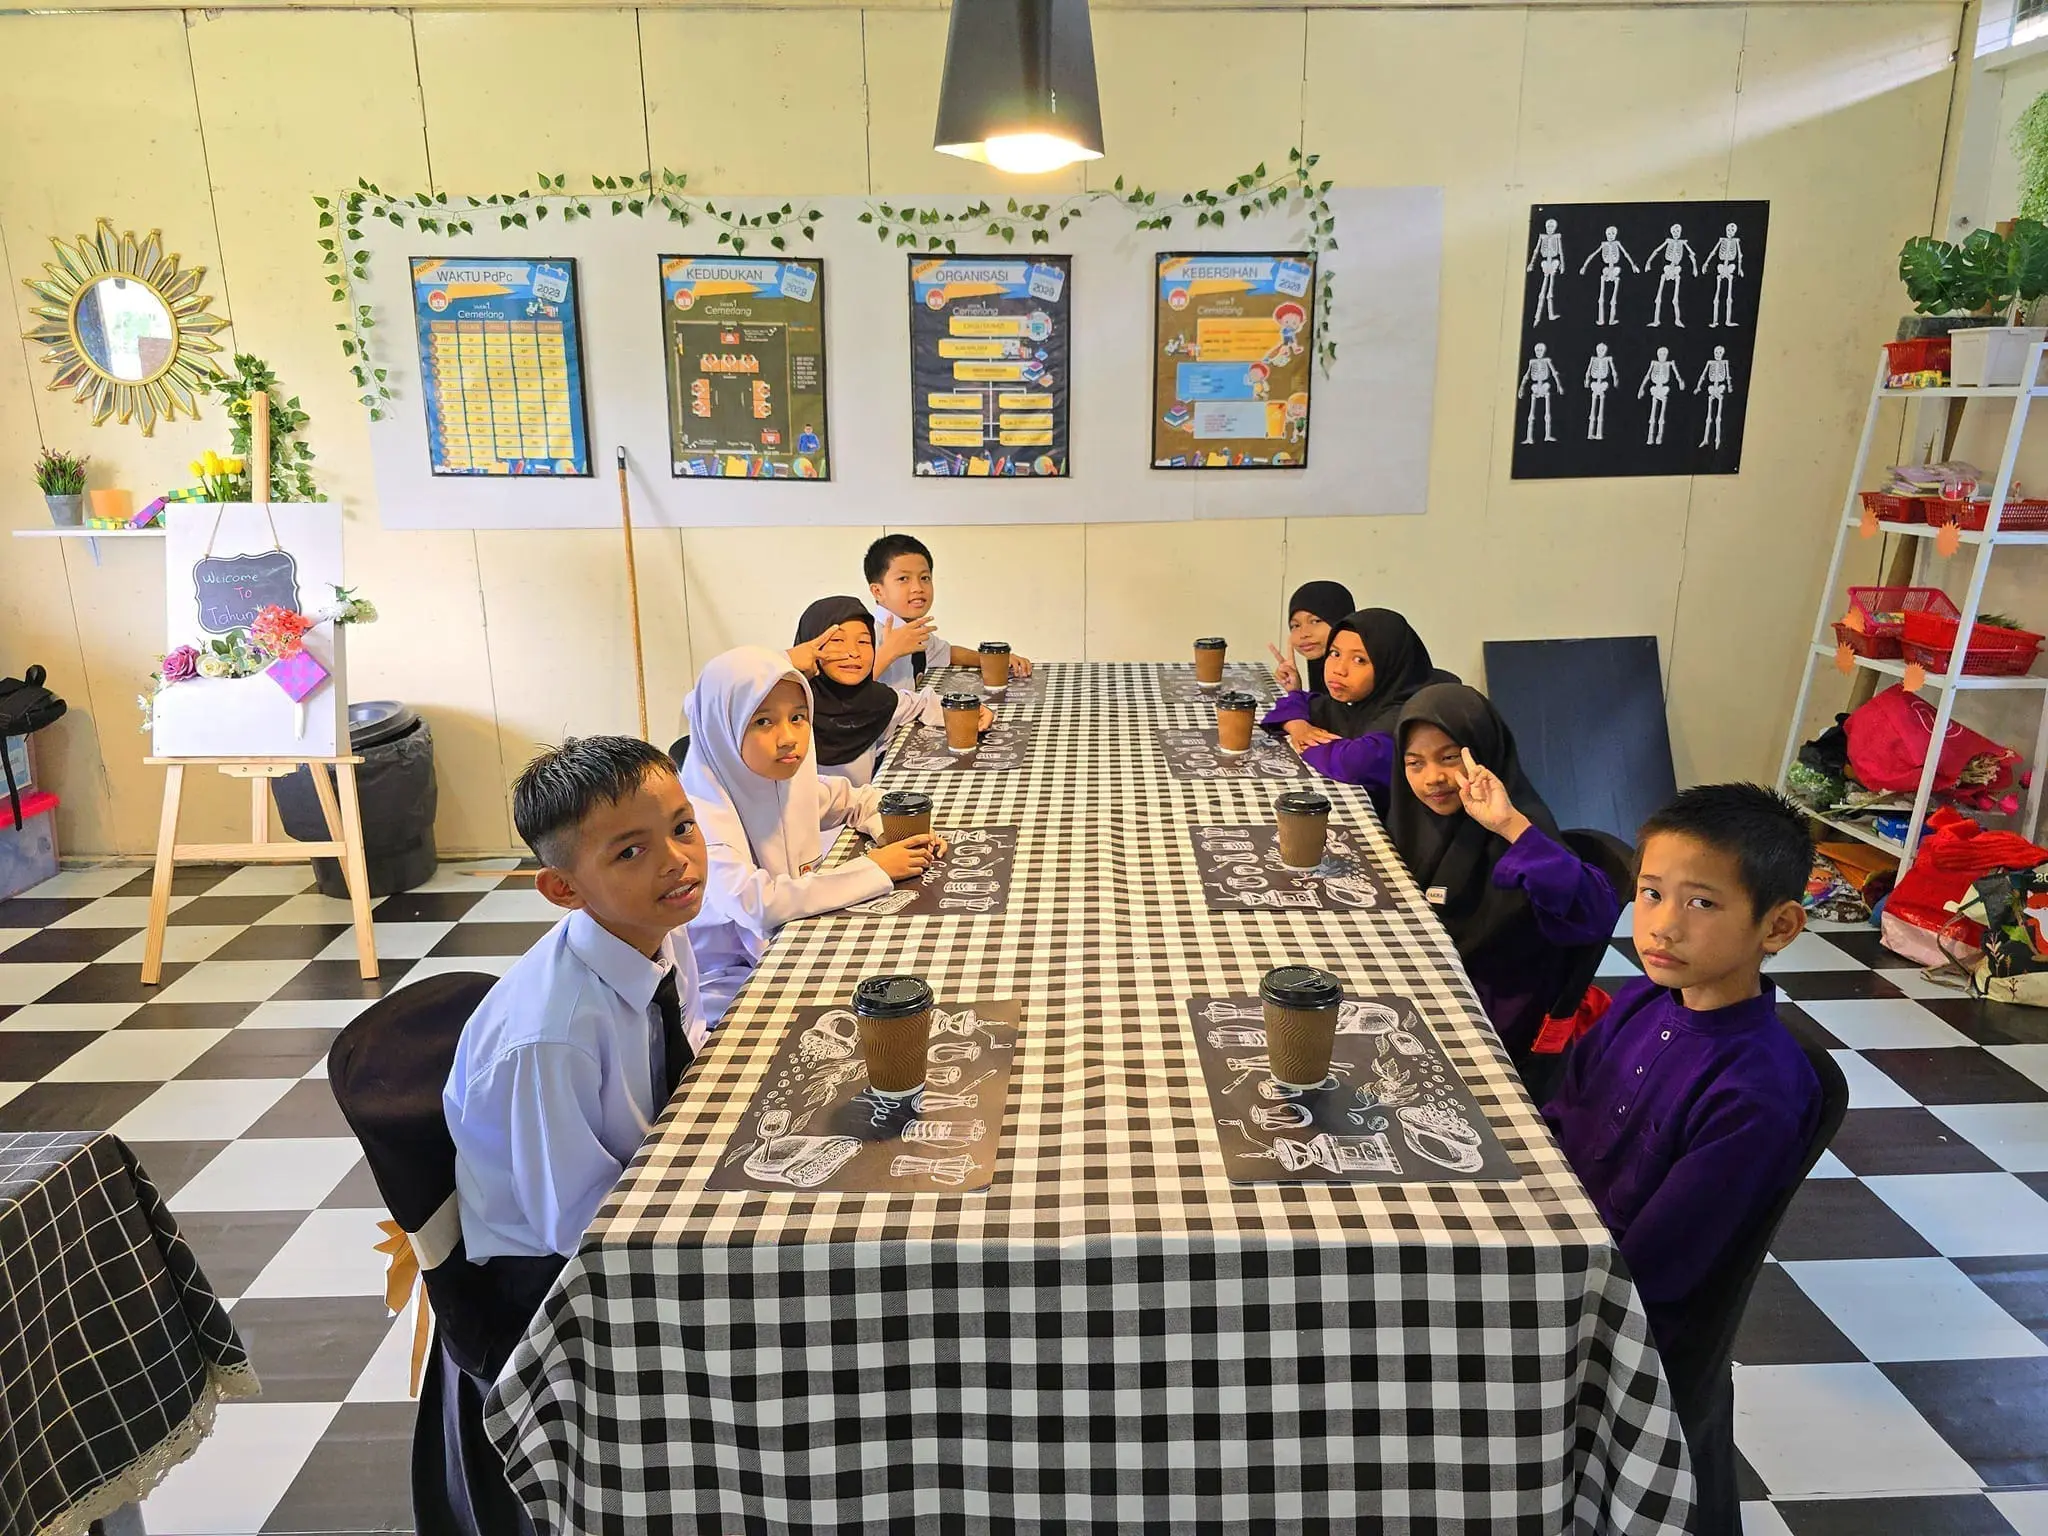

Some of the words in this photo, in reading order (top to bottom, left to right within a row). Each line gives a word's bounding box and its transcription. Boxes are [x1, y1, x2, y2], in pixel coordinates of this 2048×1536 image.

[436, 270, 480, 283] WAKTU
[483, 271, 513, 283] PdPc
[686, 268, 763, 281] KEDUDUKAN
[935, 270, 1009, 283] ORGANISASI
[1182, 267, 1258, 279] KEBERSIHAN
[537, 283, 561, 298] 2023
[457, 310, 505, 320] Cemerlang
[704, 305, 752, 317] Cemerlang
[952, 306, 999, 316] Cemerlang
[232, 585, 253, 601] To
[207, 604, 255, 626] Tahun
